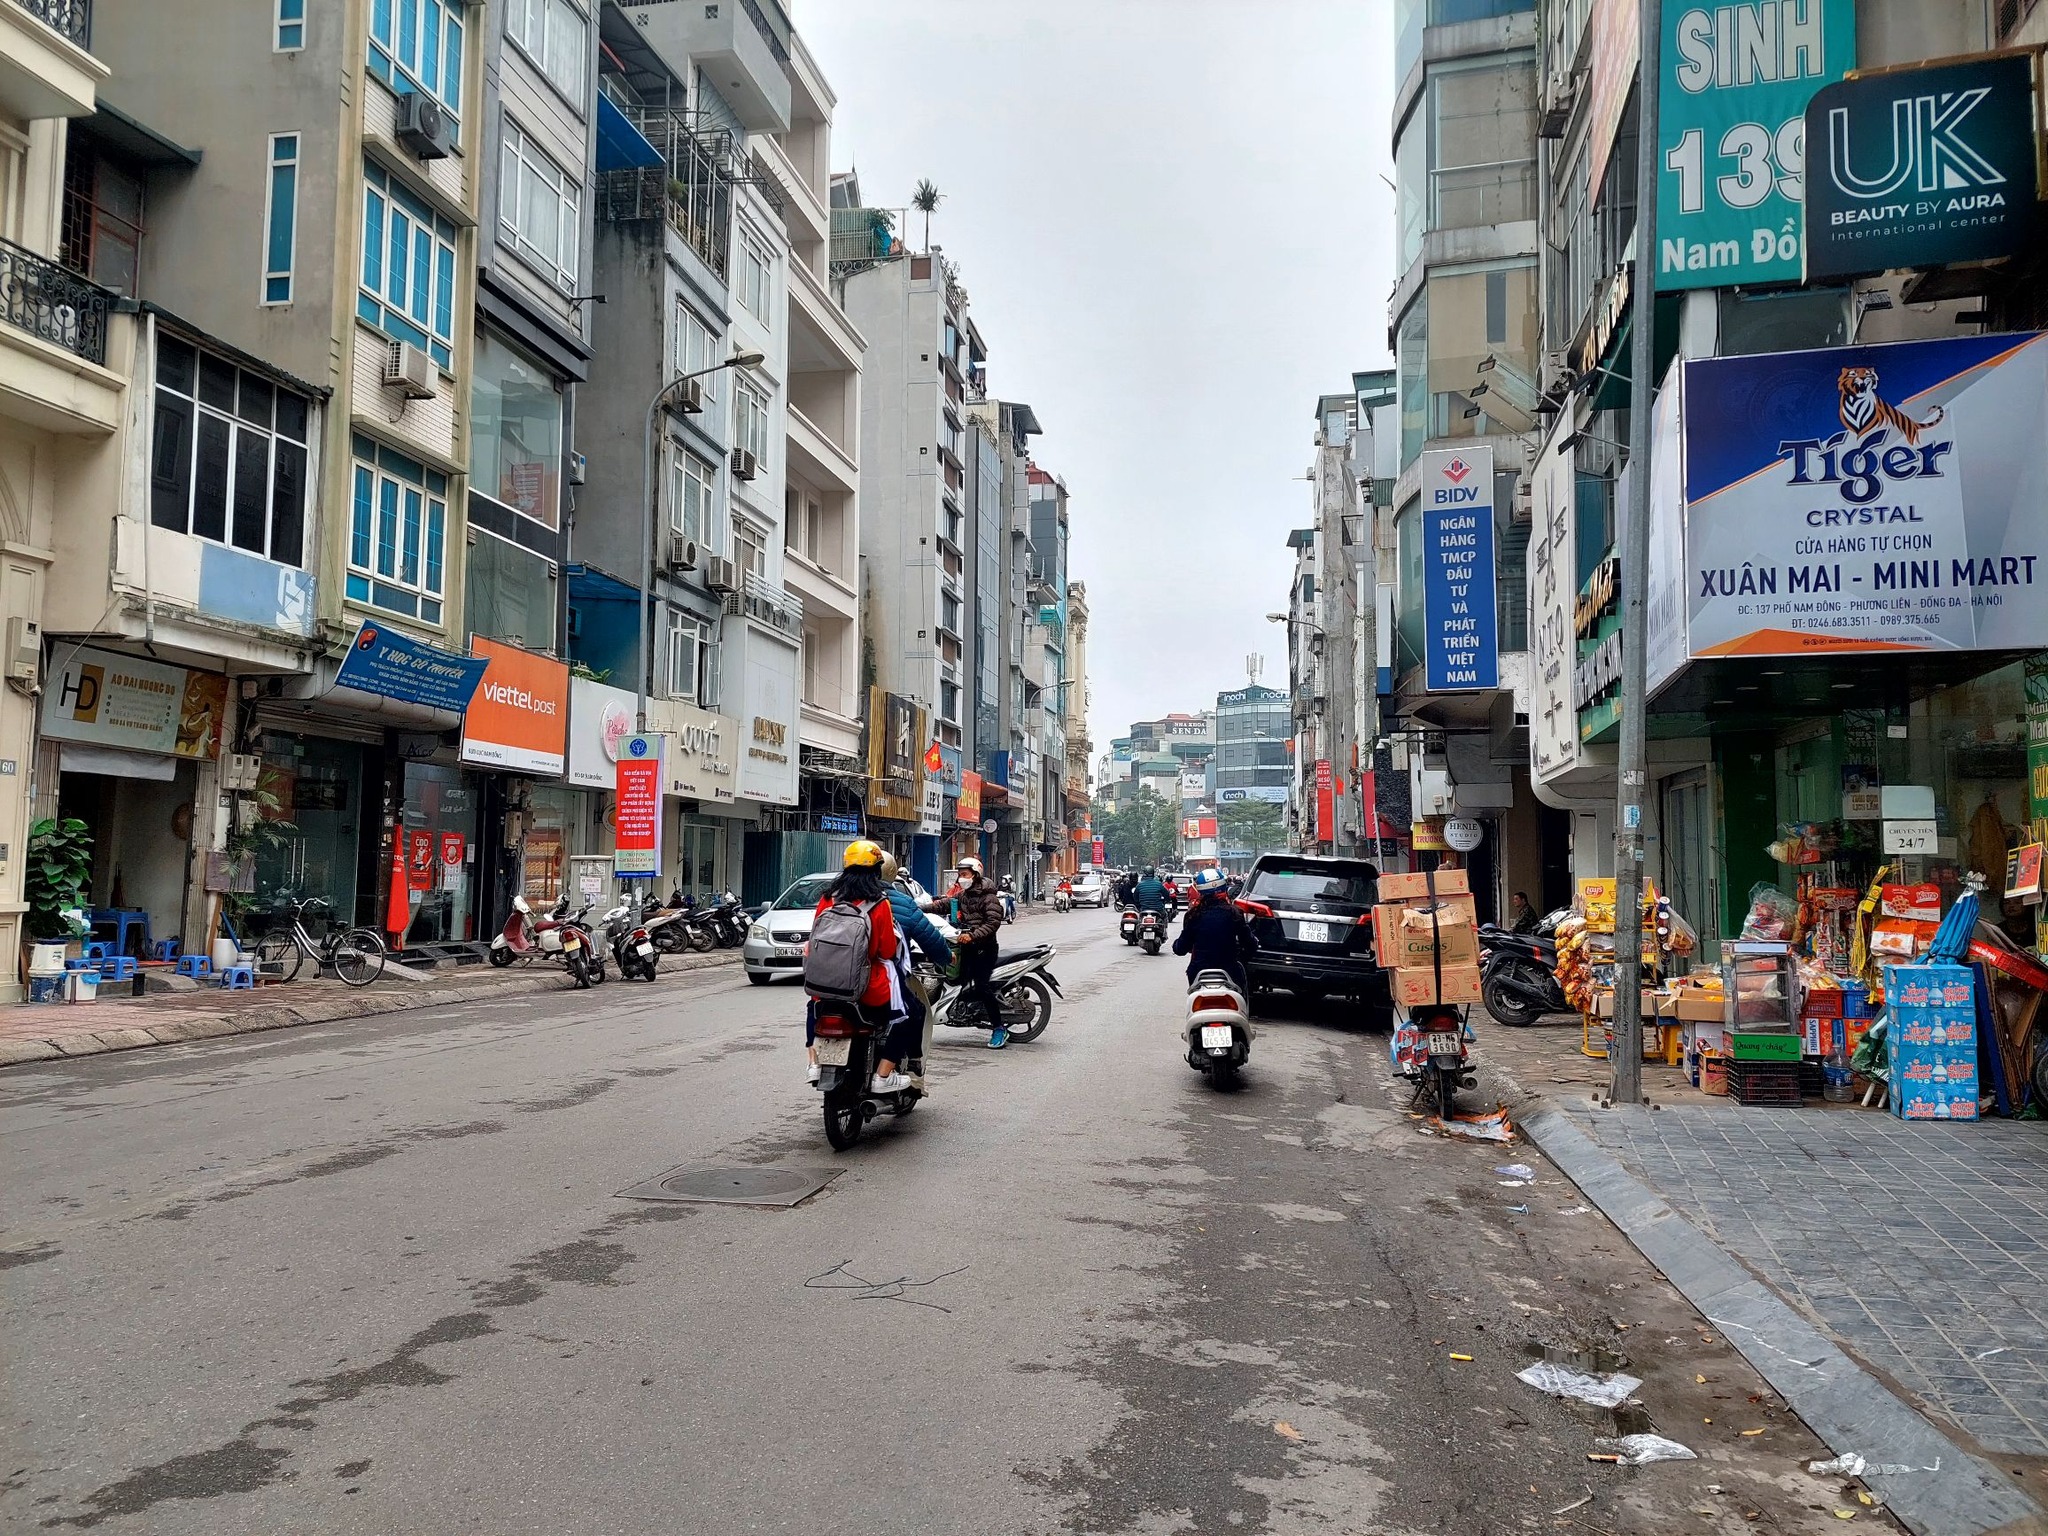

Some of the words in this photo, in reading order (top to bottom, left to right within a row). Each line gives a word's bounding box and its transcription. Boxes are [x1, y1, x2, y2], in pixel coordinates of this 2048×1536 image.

[1675, 0, 1825, 94] SINH
[1829, 86, 2008, 200] UK
[1830, 204, 1911, 227] BEAUTY
[1915, 201, 1942, 217] BY
[1945, 192, 2006, 214] AURA
[1831, 219, 1943, 242] International
[1949, 213, 2006, 229] center
[1662, 237, 1740, 274] Nam
[1751, 217, 1804, 264] Đồ
[1776, 428, 1953, 506] Tiger
[1434, 486, 1478, 504] BIDV
[1440, 516, 1476, 531] NGÂN
[1806, 504, 1924, 528] CRYSTAL
[1440, 531, 1476, 548] HÀNG
[1795, 535, 1826, 555] CỬA
[1827, 534, 1867, 554] HÀNG
[1870, 533, 1888, 553] TỰ
[1892, 533, 1933, 553] CHỌN
[1441, 550, 1476, 565] TMCP
[1446, 565, 1472, 581] ĐẦU
[1700, 561, 1778, 598] XUÂN
[1788, 564, 1842, 594] MAI
[1873, 559, 1941, 591] MINI
[1951, 554, 2038, 588] MART
[1450, 583, 1468, 597] TƯ
[1451, 599, 1468, 614] VÀ
[1737, 605, 1753, 615] ĐC:
[1756, 604, 1771, 614] 137
[1793, 602, 1814, 613] NAM
[1891, 597, 1911, 609] LIÊN
[1949, 597, 1962, 607] ĐA
[1971, 594, 1984, 606] HÀ
[1986, 593, 2003, 607] NỘI
[1444, 616, 1476, 631] PHÁT
[1792, 618, 1806, 629] ĐT:
[1808, 615, 1871, 629] 0246.683.3511
[1880, 613, 1941, 626] 0989.375.665
[1443, 633, 1479, 650] TRIỂN
[378, 646, 389, 659] Y
[387, 649, 412, 666] HỌC
[426, 661, 466, 680] TRUYỀN
[1447, 652, 1475, 668] VIỆT
[1447, 669, 1477, 683] NAM
[483, 681, 533, 710] viettel
[533, 698, 556, 716] post
[1224, 691, 1247, 702] inochi
[1260, 689, 1290, 700] inochi
[1172, 727, 1191, 735] SEN
[1193, 727, 1207, 735] DA
[2, 761, 14, 773] 60
[1225, 790, 1245, 800] inochi
[1449, 822, 1478, 831] HENIE
[1898, 837, 1925, 848] 24/7
[1306, 923, 1322, 932] 30G
[776, 948, 803, 956] 30A-429
[1408, 942, 1448, 953] Custs
[1809, 1019, 1818, 1053] SAPPHIRE
[1736, 1041, 1760, 1052] Quang
